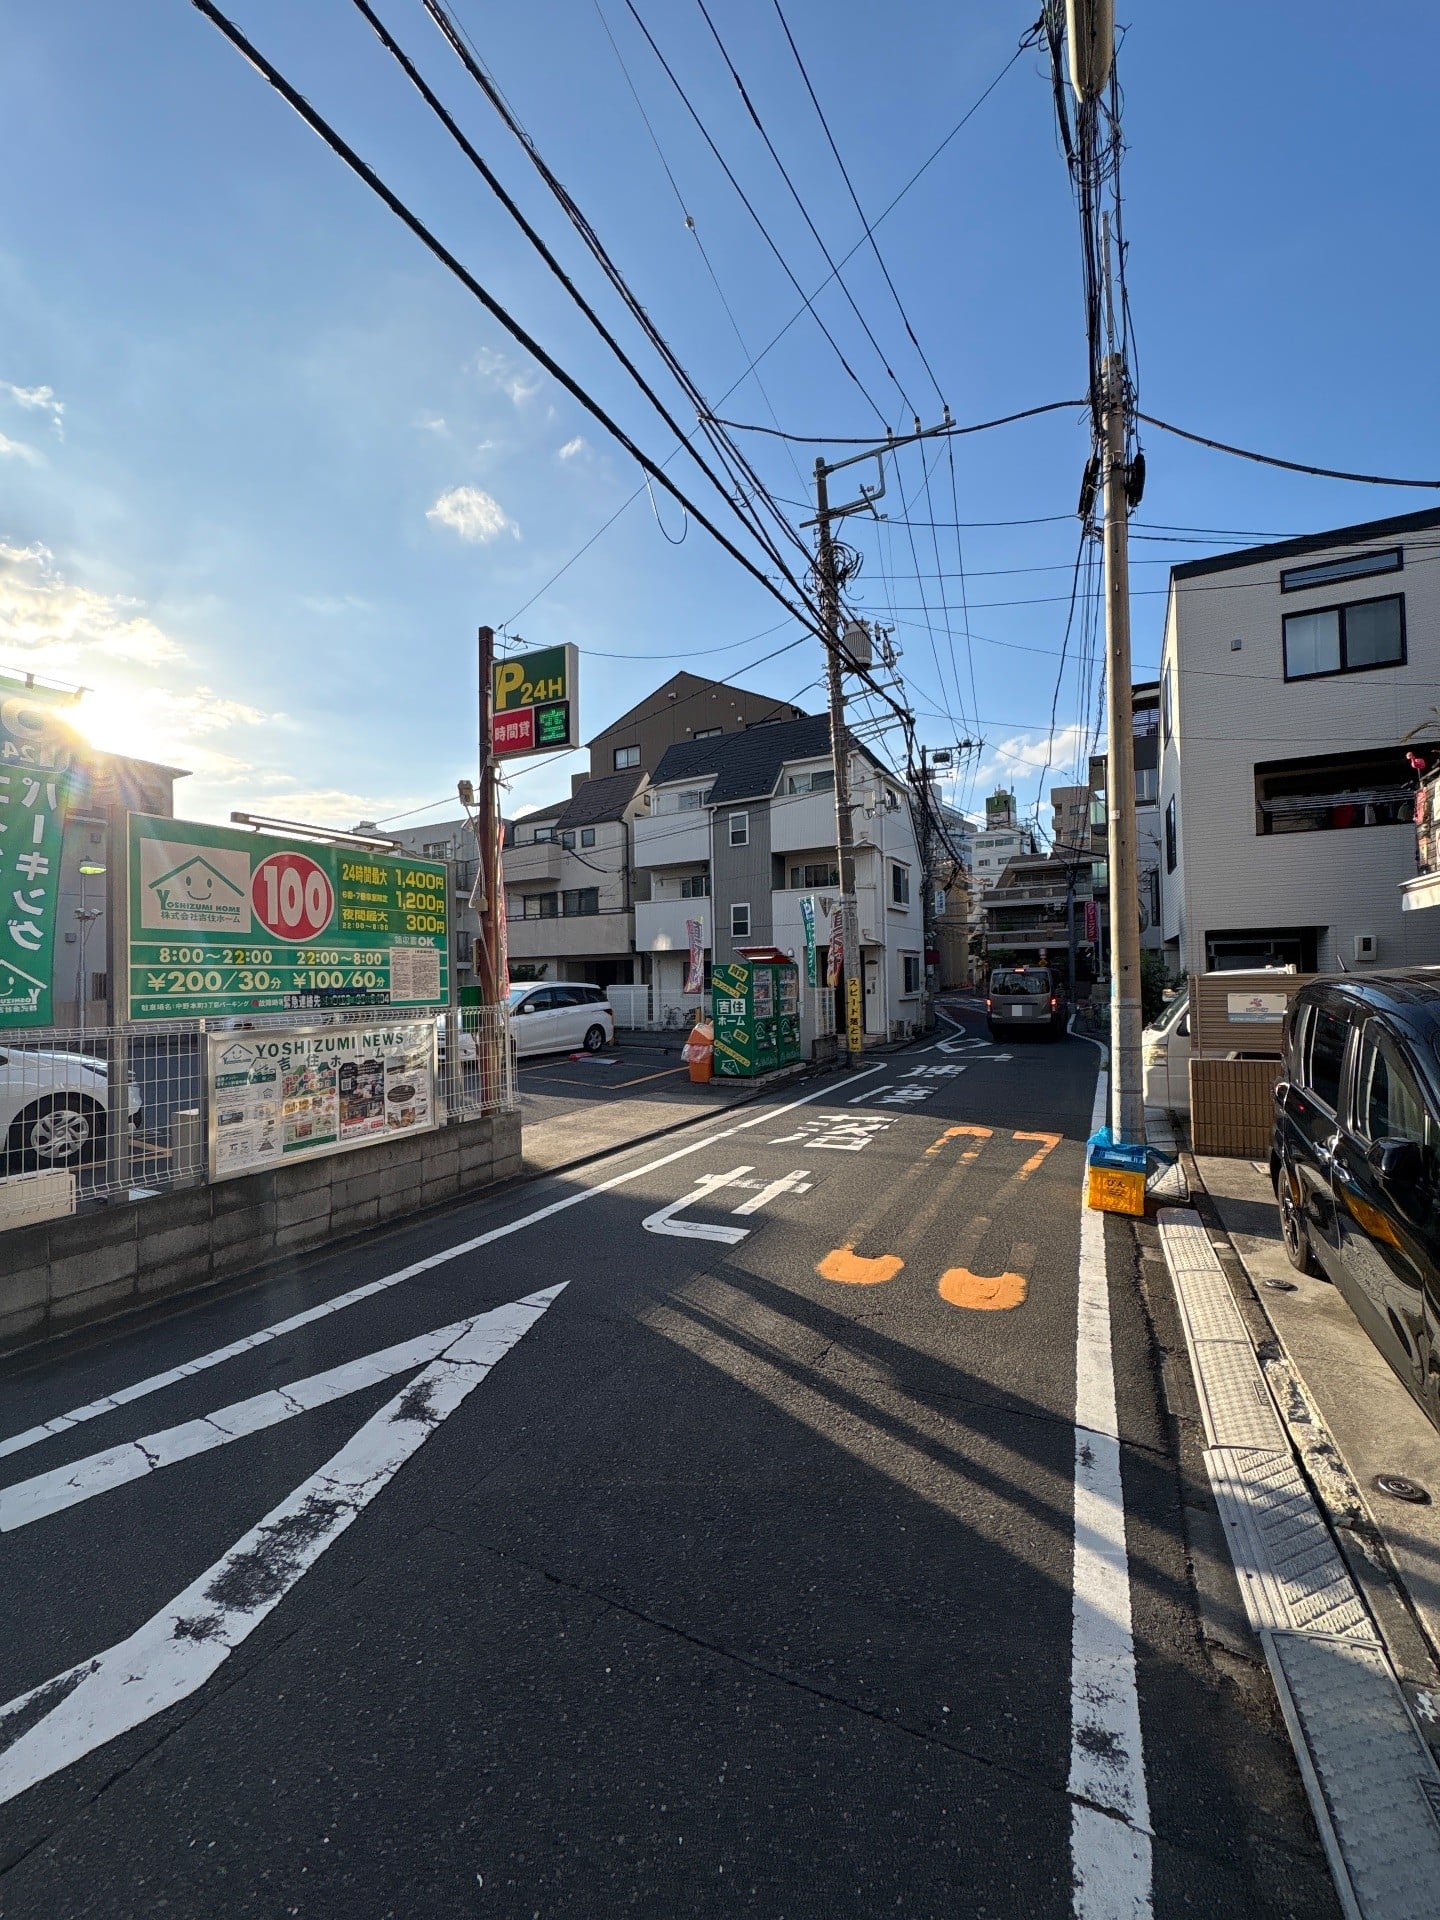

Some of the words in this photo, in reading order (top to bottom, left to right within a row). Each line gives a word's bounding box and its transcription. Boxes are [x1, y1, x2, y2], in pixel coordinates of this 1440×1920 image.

[495, 662, 525, 710] P
[520, 677, 563, 704] 24H
[495, 721, 531, 741] 時間貸
[343, 863, 388, 886] 24時間最大
[396, 868, 444, 890] 1,400円
[156, 889, 213, 910] YOSHIZUMI
[215, 904, 241, 913] HOME
[263, 865, 328, 929] 100
[396, 891, 445, 913] 1,200円
[160, 911, 241, 923] 株式会社吉住ホーム
[342, 908, 388, 923] 夜間最大
[406, 914, 445, 934] 300円
[718, 1000, 746, 1015] 吉住
[718, 1016, 745, 1026] ホーム
[255, 1036, 356, 1058] YOSHIZUMI
[362, 1032, 404, 1048] NEWS
